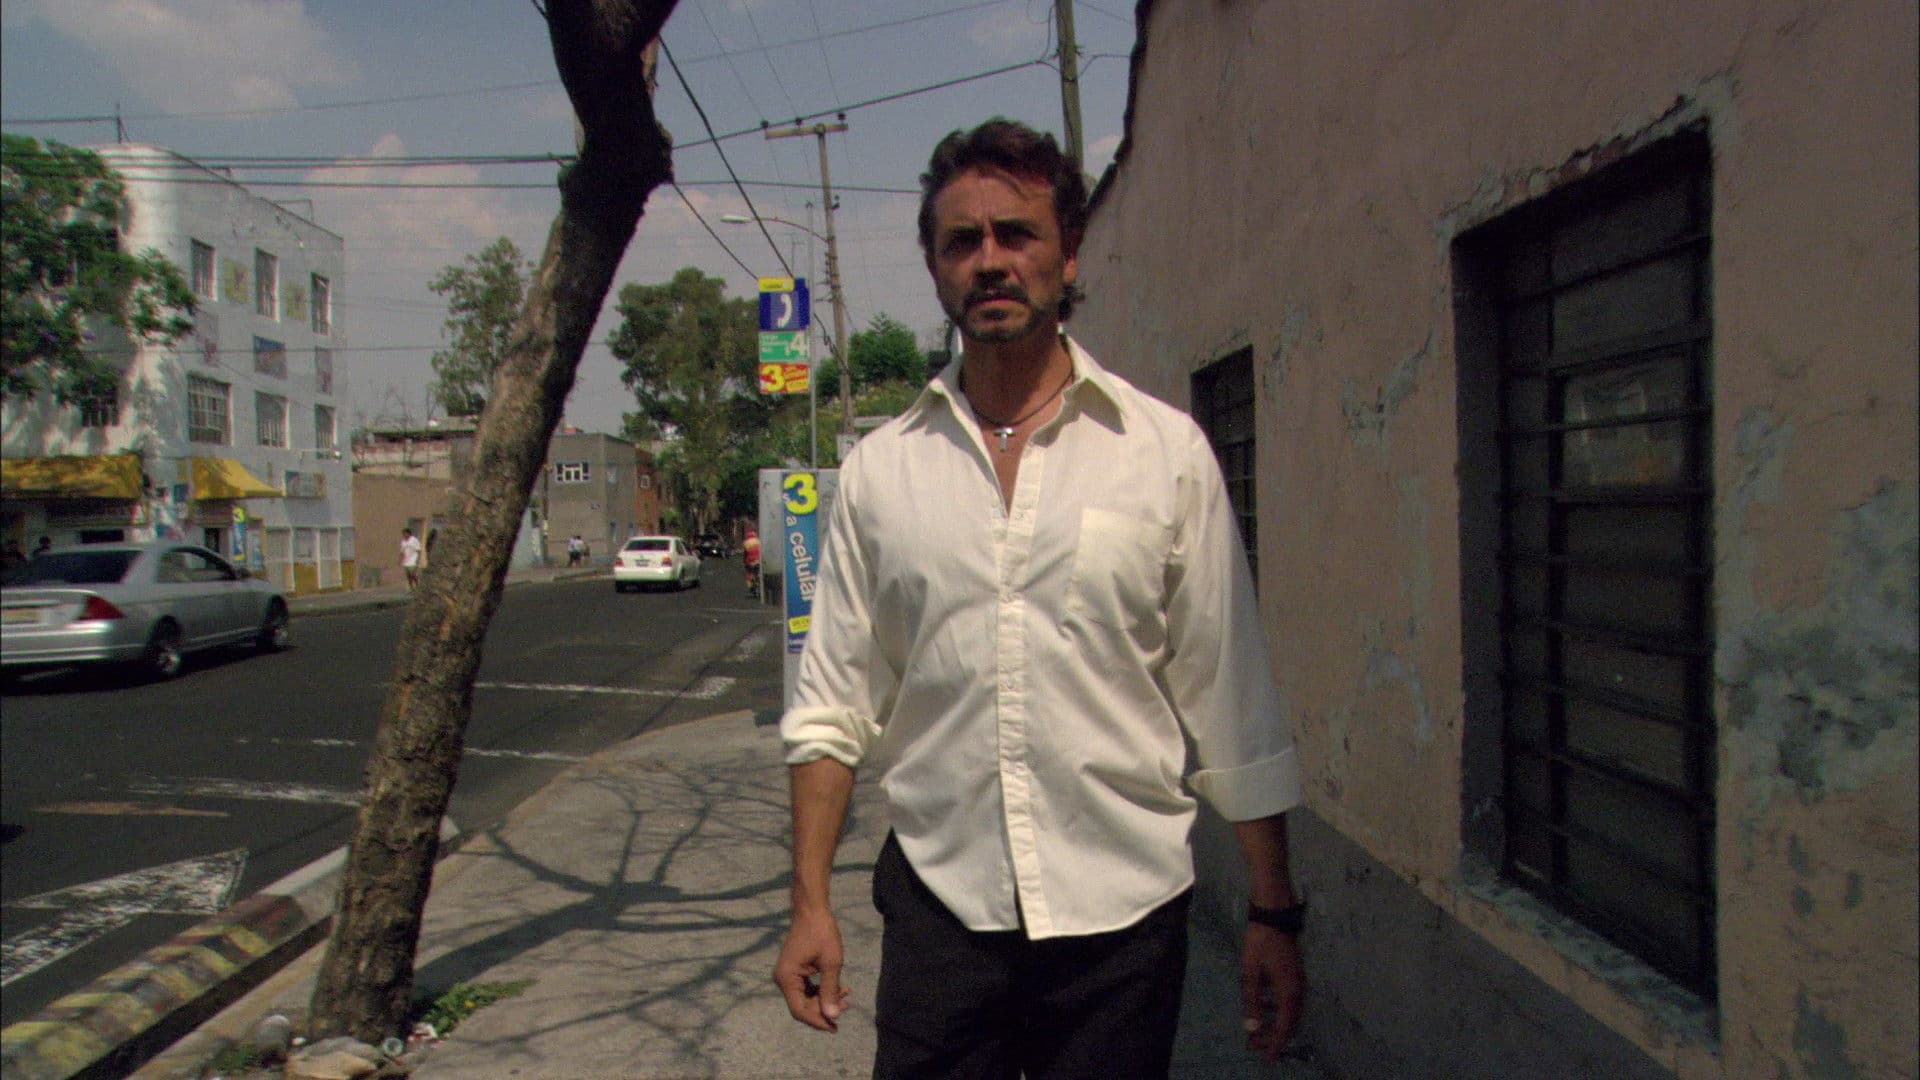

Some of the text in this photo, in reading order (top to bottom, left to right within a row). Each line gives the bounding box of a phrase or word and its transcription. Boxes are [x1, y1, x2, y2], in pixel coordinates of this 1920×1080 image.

[762, 364, 785, 392] 3
[783, 472, 818, 515] 3
[786, 515, 797, 527] a
